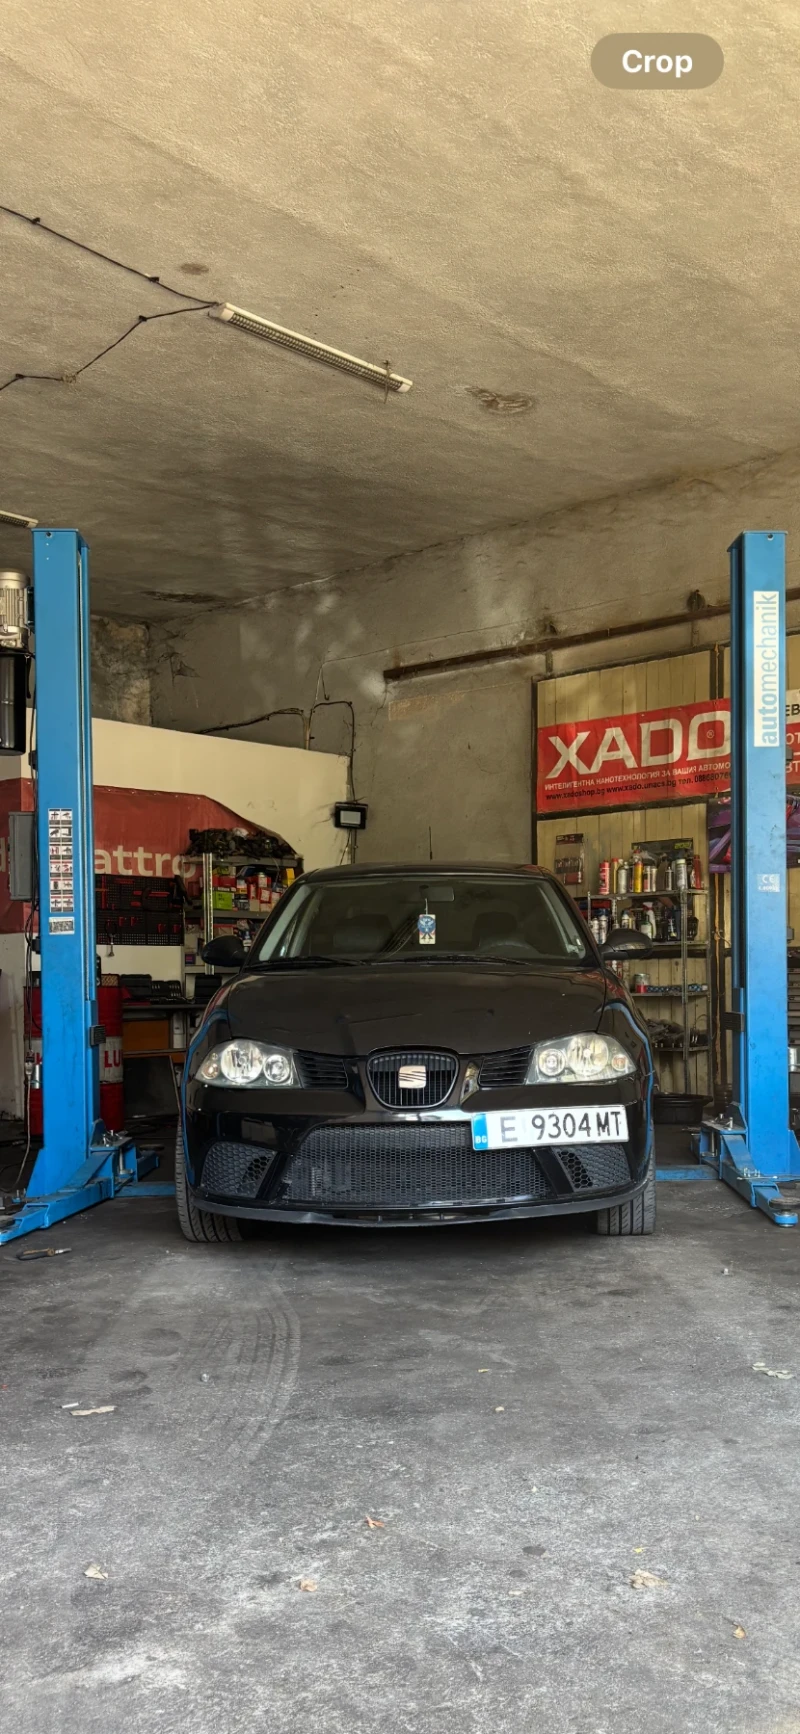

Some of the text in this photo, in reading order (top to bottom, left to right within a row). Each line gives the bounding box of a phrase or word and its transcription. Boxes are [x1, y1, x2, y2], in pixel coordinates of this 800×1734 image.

[756, 593, 777, 744] automechanik
[545, 710, 731, 778] XADO
[544, 779, 595, 791] ИНТЕЛИГЕНТНА
[596, 769, 660, 785] НАНОТЕХНОЛОГИЯ
[672, 766, 697, 776] ВАШИЯ
[698, 762, 731, 772] АВТОМО
[545, 787, 605, 800] www.xadoshop.bg
[475, 1135, 488, 1144] BG
[500, 1110, 621, 1143] E 9304 MT
